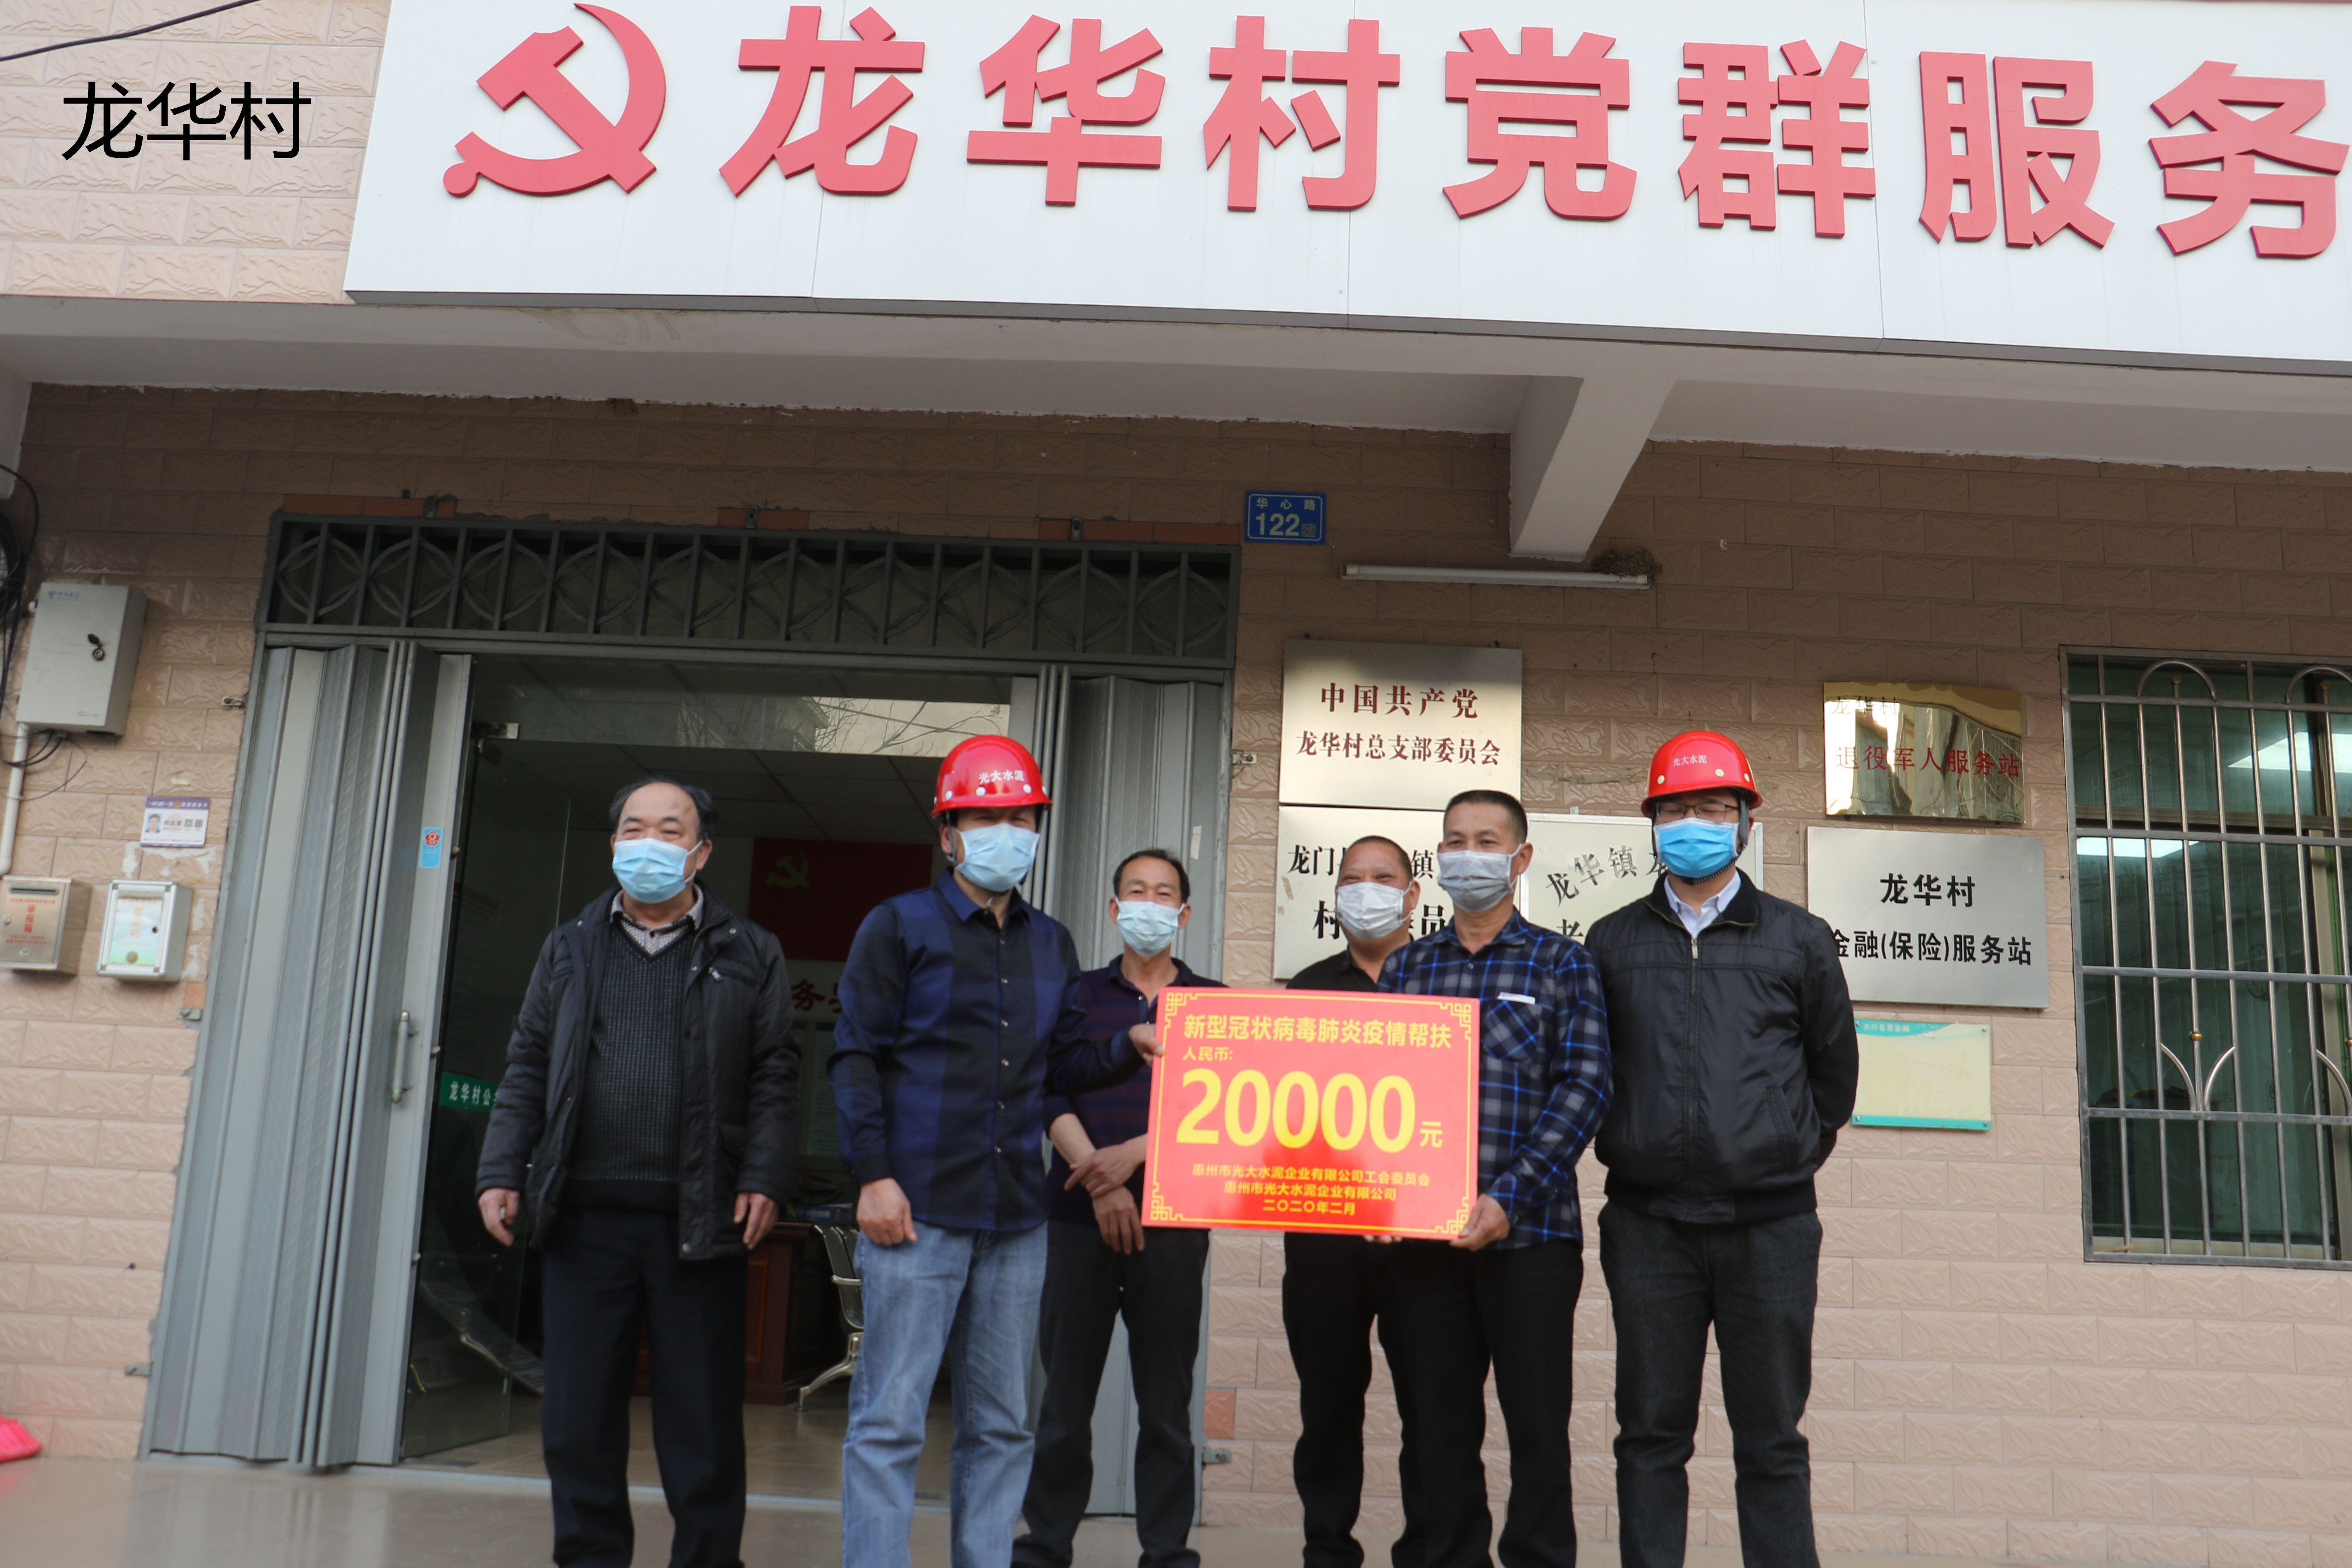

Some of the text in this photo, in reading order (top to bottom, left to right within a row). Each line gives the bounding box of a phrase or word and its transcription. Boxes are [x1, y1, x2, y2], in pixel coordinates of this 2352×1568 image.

[720, 5, 2350, 259] 龙华村党群服务
[1256, 497, 1315, 510] 华心路
[1256, 512, 1299, 536] 122
[1321, 683, 1479, 718] 中国共产党
[1832, 696, 1900, 715] 龙华村
[1296, 730, 1501, 766] 龙华村总支部委员会
[1673, 754, 1707, 768] 光大水泥
[1835, 746, 2020, 777] 退役军人服务站
[978, 769, 1025, 784] 光大水泥
[1880, 873, 1975, 907] 龙华村
[1833, 928, 2032, 965] 金融(保险)服务站
[1183, 1014, 1452, 1049] 新型冠状病毒肺炎疫情帮扶
[449, 1080, 498, 1107] 龙华村公
[1191, 1163, 1430, 1186] 惠州市光大水泥企业有限公司工会委员会
[1223, 1180, 1396, 1201] 惠州市光大水泥企业有限公司
